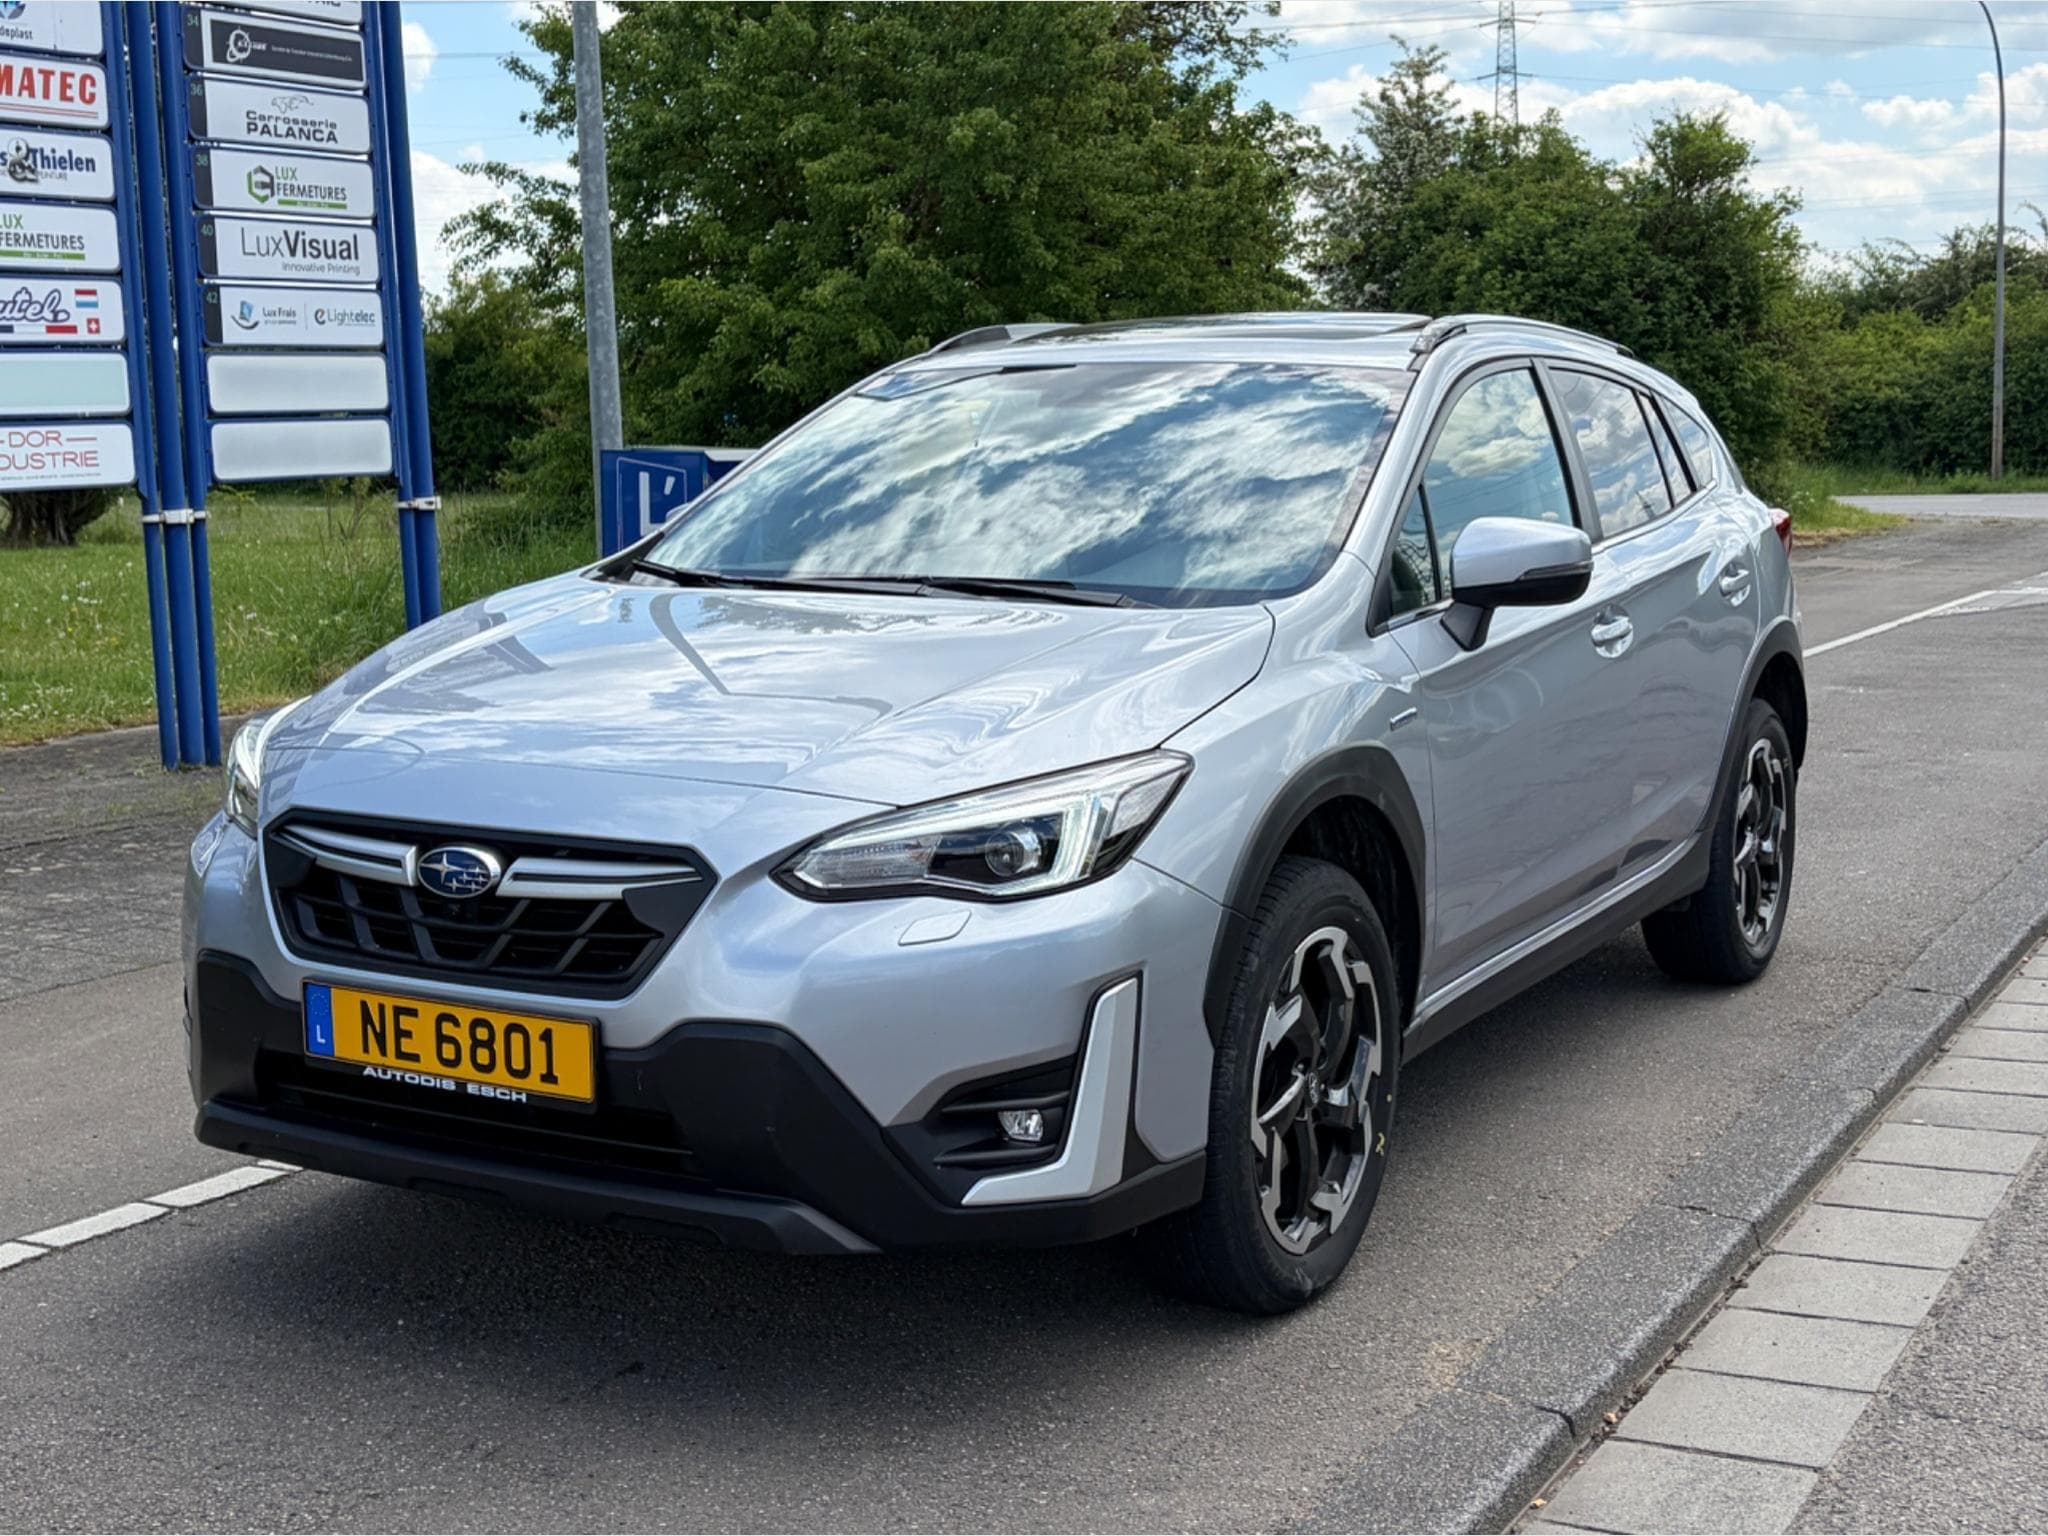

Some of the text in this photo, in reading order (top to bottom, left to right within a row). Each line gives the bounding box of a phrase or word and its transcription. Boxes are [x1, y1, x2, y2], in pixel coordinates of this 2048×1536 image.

[187, 14, 199, 27] 34
[0, 64, 97, 105] MATEC
[190, 84, 203, 96] 36
[246, 110, 338, 129] Carrosserie
[246, 122, 338, 144] PALANCA
[30, 147, 97, 173] Thielen
[196, 154, 208, 166] 38
[275, 166, 298, 182] LUX
[276, 182, 347, 201] FERMETURES
[0, 213, 24, 230] UX
[201, 224, 213, 236] 40
[0, 231, 85, 250] FERMETURES
[241, 227, 360, 261] LuxVisual
[282, 262, 360, 276] Innovative Printing
[207, 292, 218, 304] 42
[8, 430, 63, 448] DOR
[316, 1024, 326, 1044] L
[360, 1000, 559, 1085] NE 6801
[362, 1066, 528, 1104] AUTODIS ESCH
